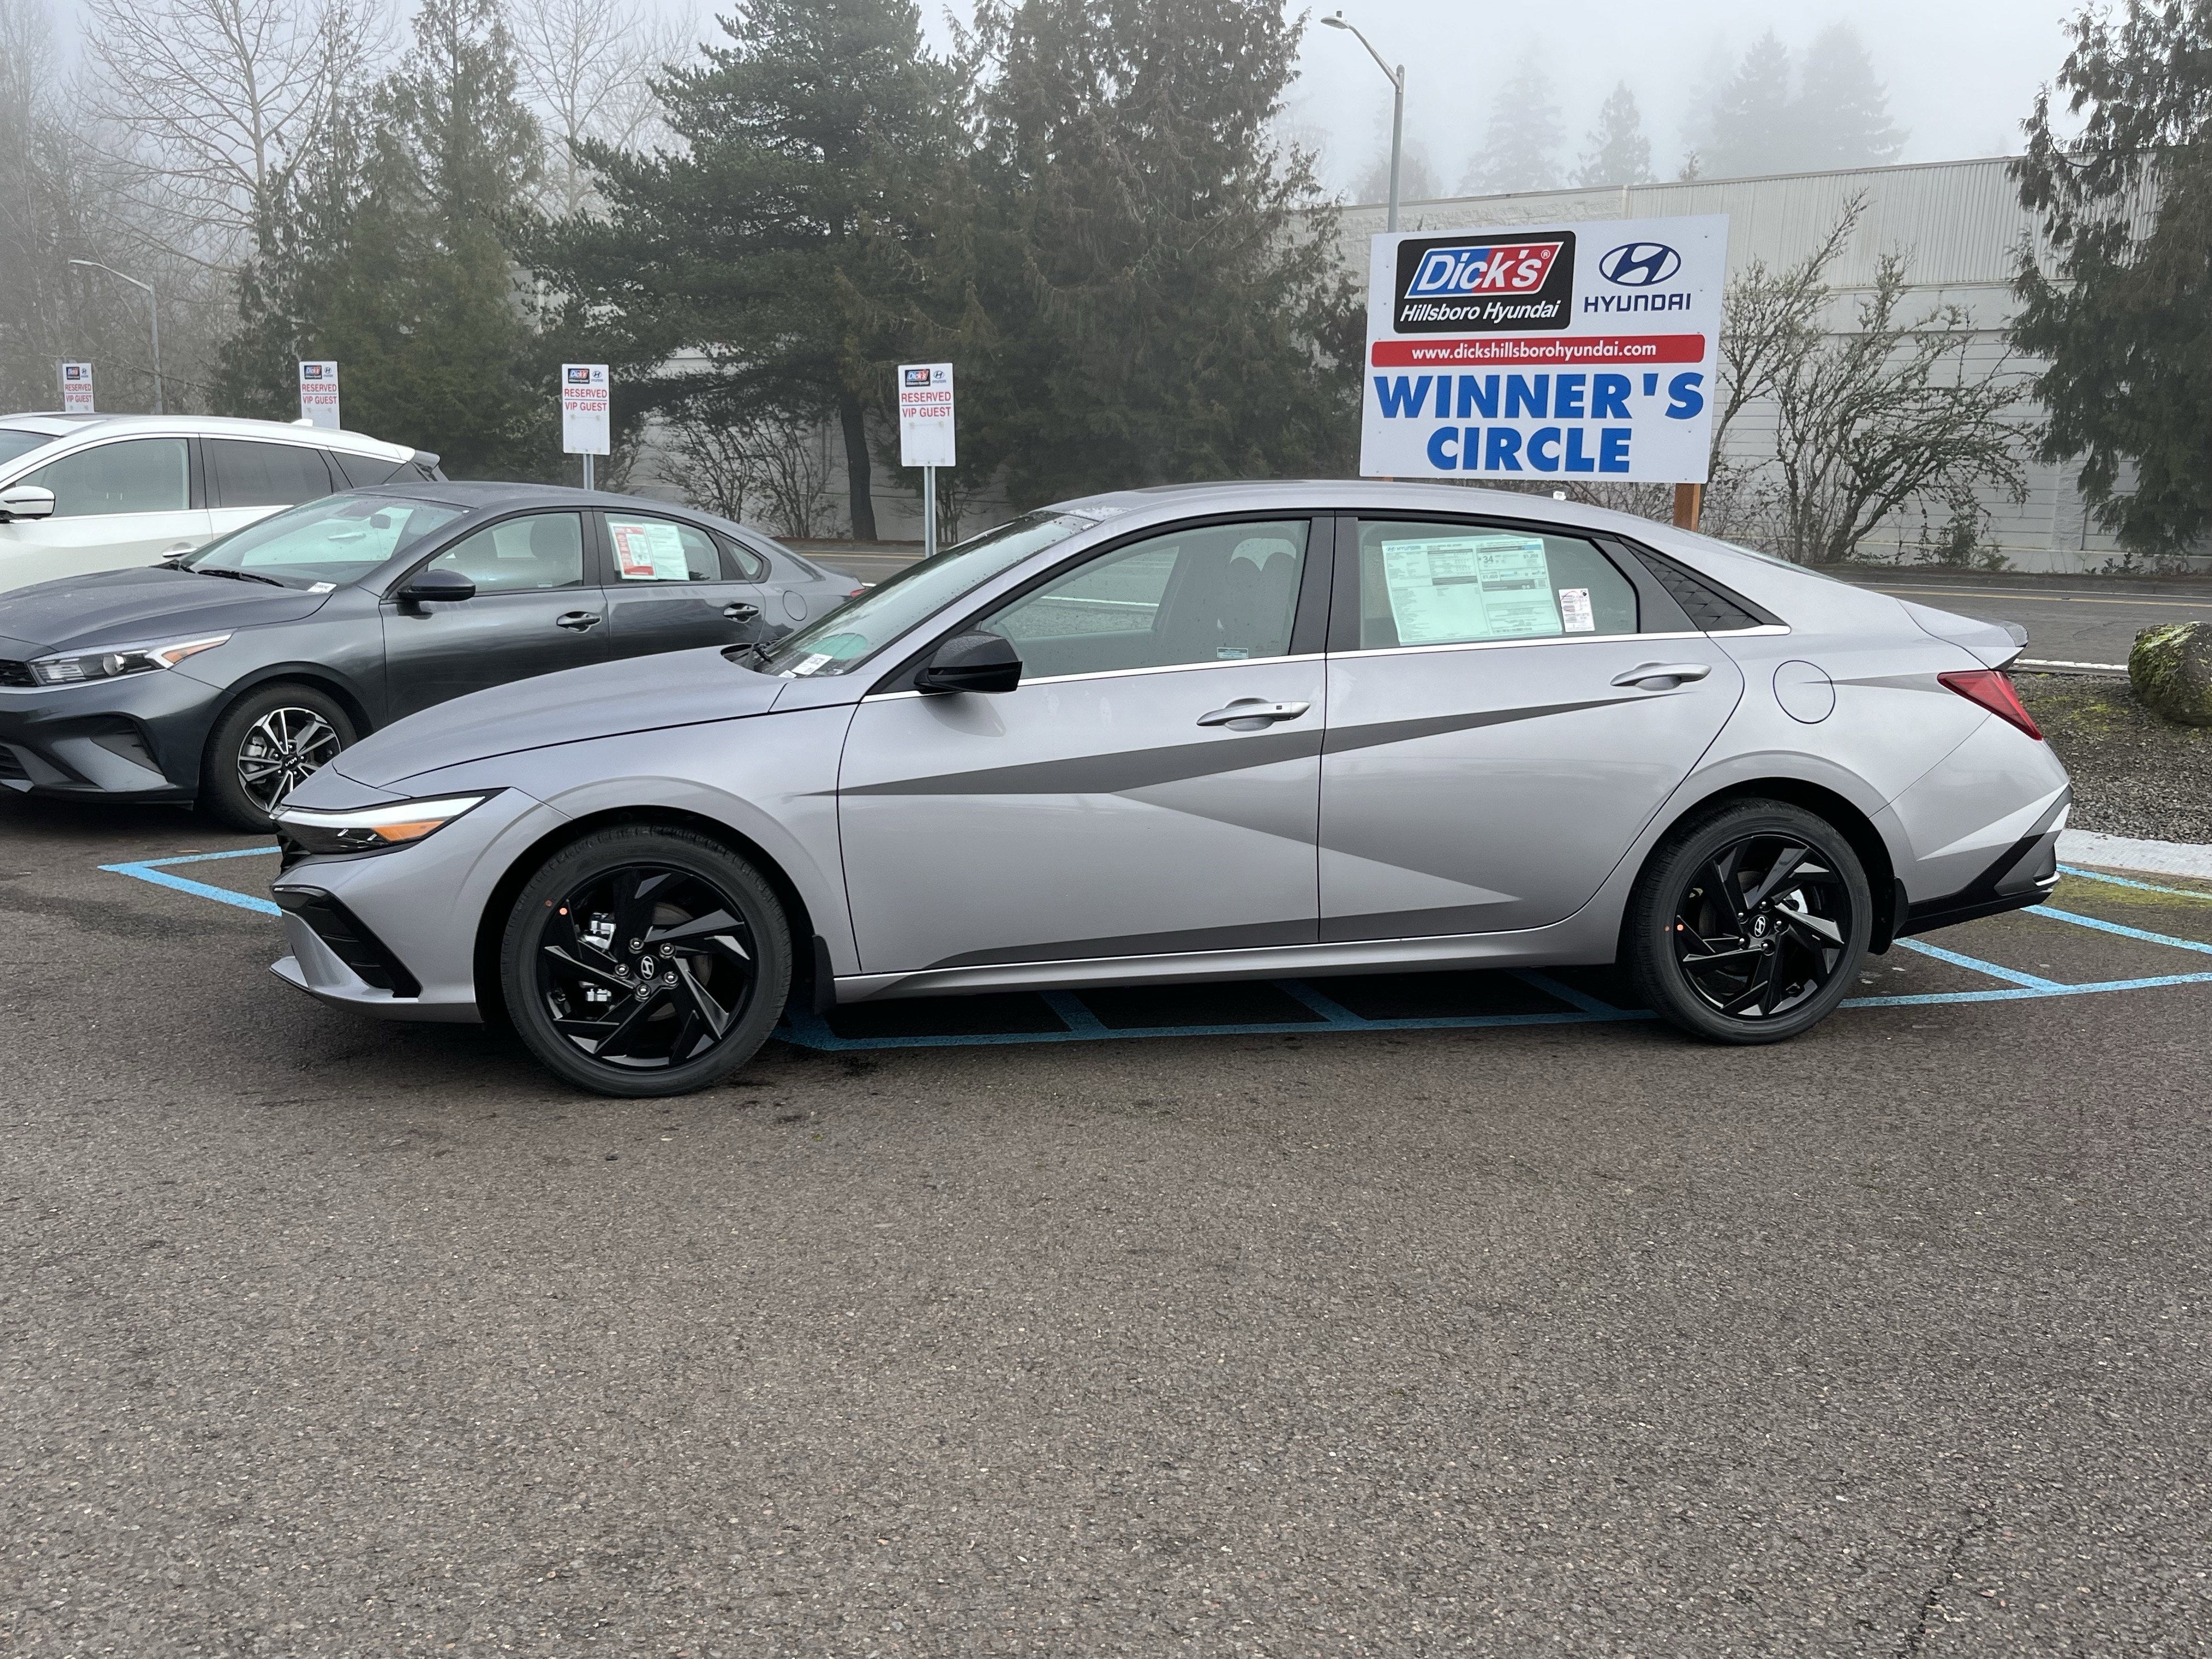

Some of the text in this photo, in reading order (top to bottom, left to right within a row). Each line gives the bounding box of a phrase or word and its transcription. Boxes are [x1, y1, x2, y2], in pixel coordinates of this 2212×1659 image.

[1417, 250, 1542, 291] Dick's
[1584, 294, 1691, 313] HYUNDAI
[1400, 300, 1561, 323] Hillsboro Hyundai
[1412, 340, 1656, 362] www.dickshillsborohyundai.com
[302, 384, 337, 392] RESERVED
[564, 388, 607, 398] RESERVED
[302, 396, 337, 404] VIP GUEST
[901, 391, 951, 403] RESERVED
[1373, 372, 1705, 420] WINNER'S
[565, 402, 607, 411] VIP GUEST
[902, 407, 951, 417] VIP GUEST
[1427, 427, 1632, 472] CIRCLE
